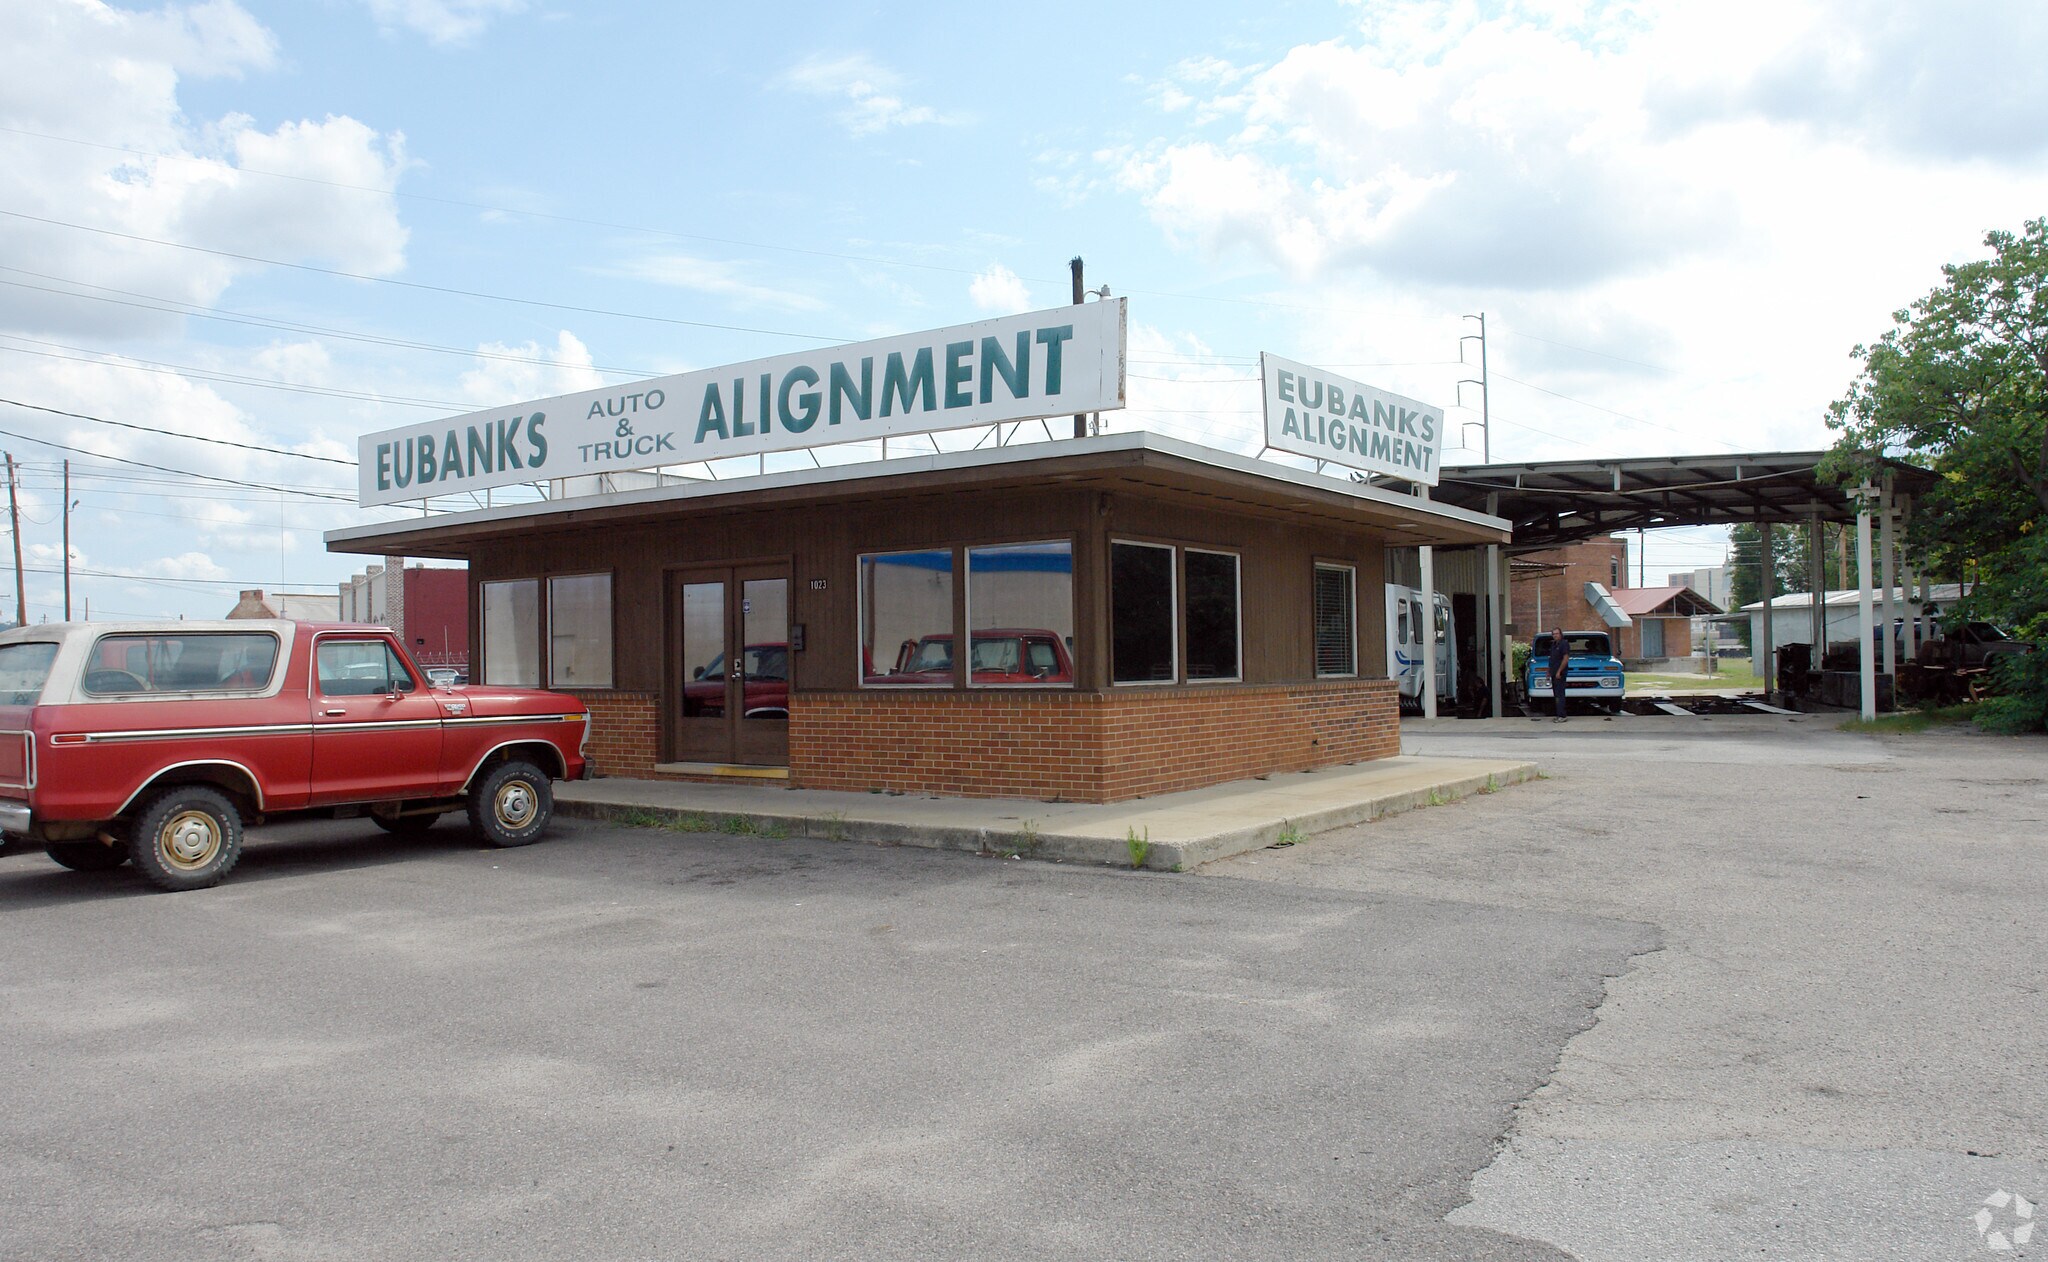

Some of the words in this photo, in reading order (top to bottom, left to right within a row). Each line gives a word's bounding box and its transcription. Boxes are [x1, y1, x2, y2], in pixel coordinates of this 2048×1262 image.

[587, 389, 665, 420] AUTO
[693, 324, 1073, 444] ALIGNMENT
[1277, 368, 1435, 443] EUBANKS
[377, 412, 548, 491] EUBANKS
[578, 431, 676, 463] TRUCK
[615, 418, 634, 437] &
[1281, 407, 1433, 473] ALIGNMENT
[810, 580, 827, 590] 1023
